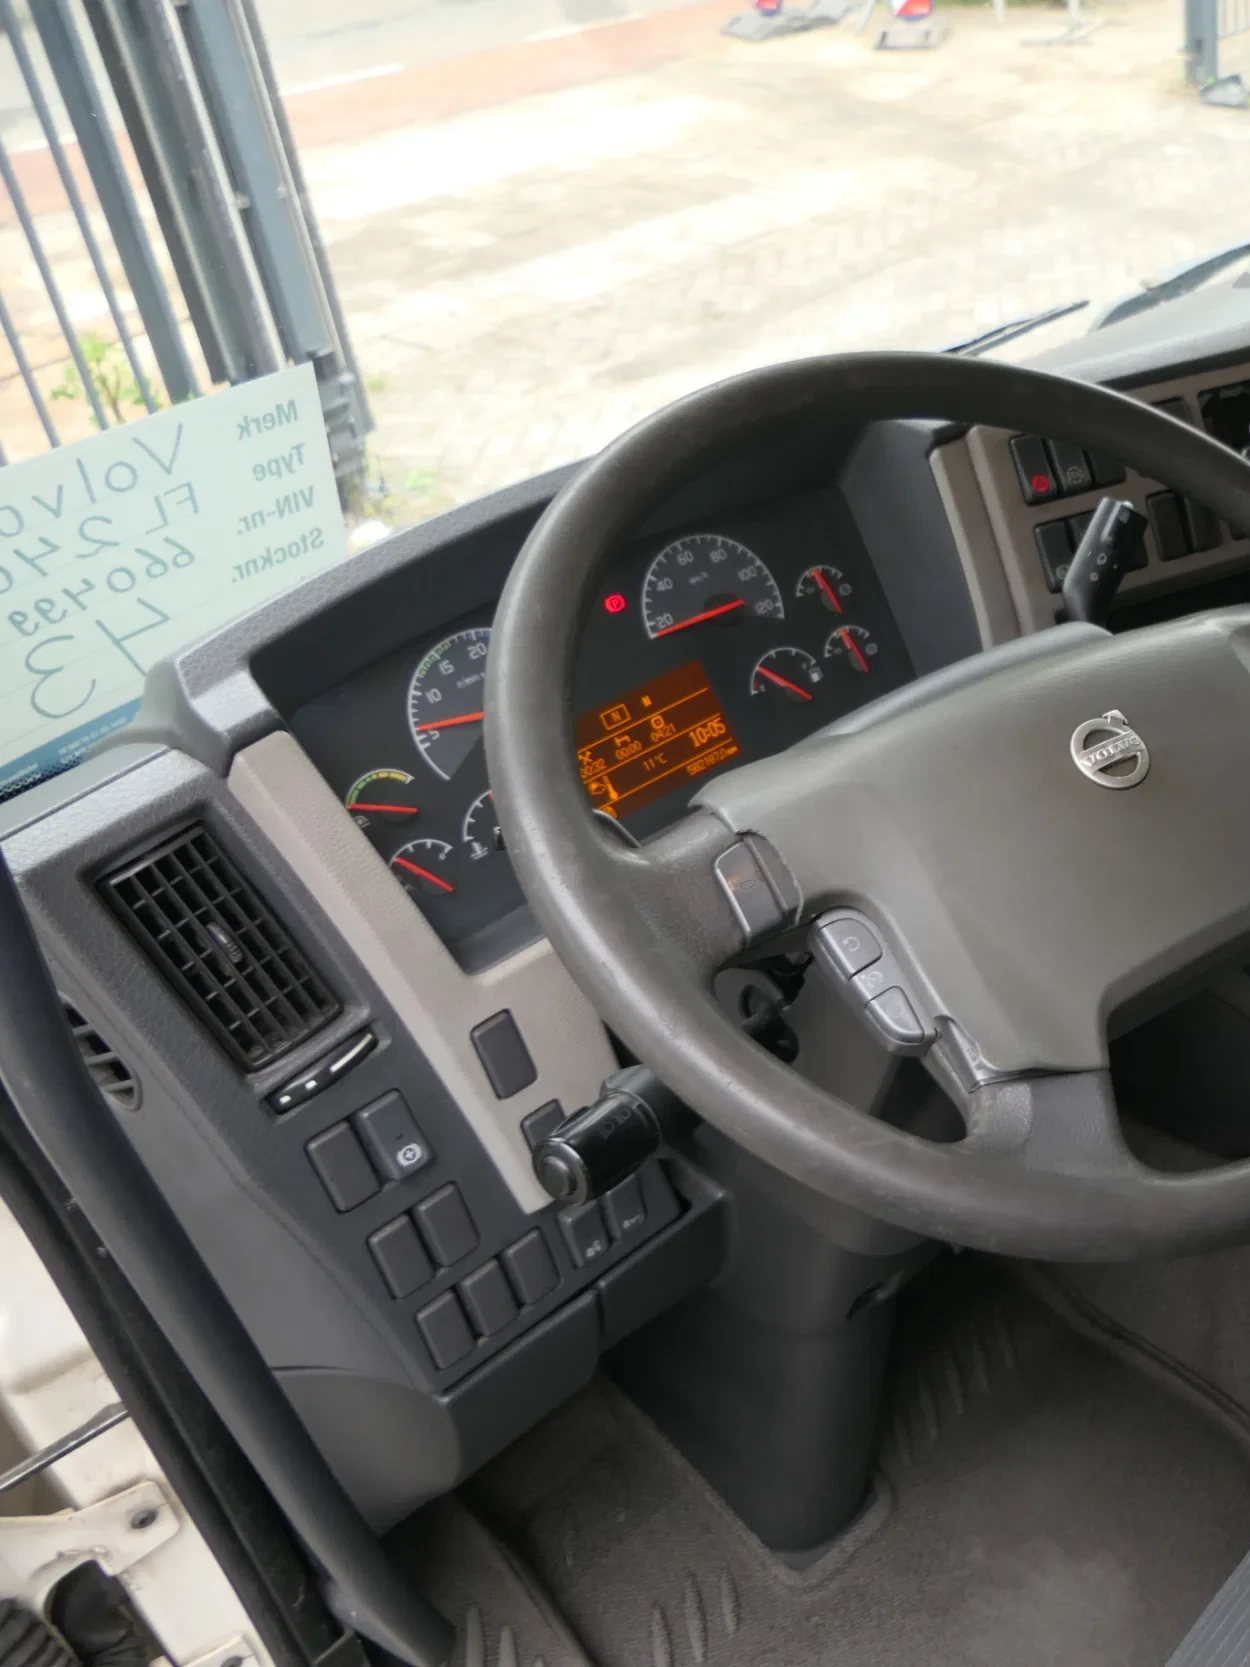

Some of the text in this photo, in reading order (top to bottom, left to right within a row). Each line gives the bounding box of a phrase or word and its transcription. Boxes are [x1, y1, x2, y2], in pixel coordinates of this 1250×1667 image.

[676, 551, 694, 566] 60
[709, 549, 727, 564] 80
[737, 566, 757, 582] 100
[656, 577, 674, 592] 40
[754, 599, 774, 615] 120
[656, 612, 674, 629] 20
[467, 642, 488, 660] 20
[438, 660, 455, 676] 15
[425, 688, 442, 704] 10
[688, 717, 727, 748] 10:05
[1081, 735, 1142, 767] VOLVO
